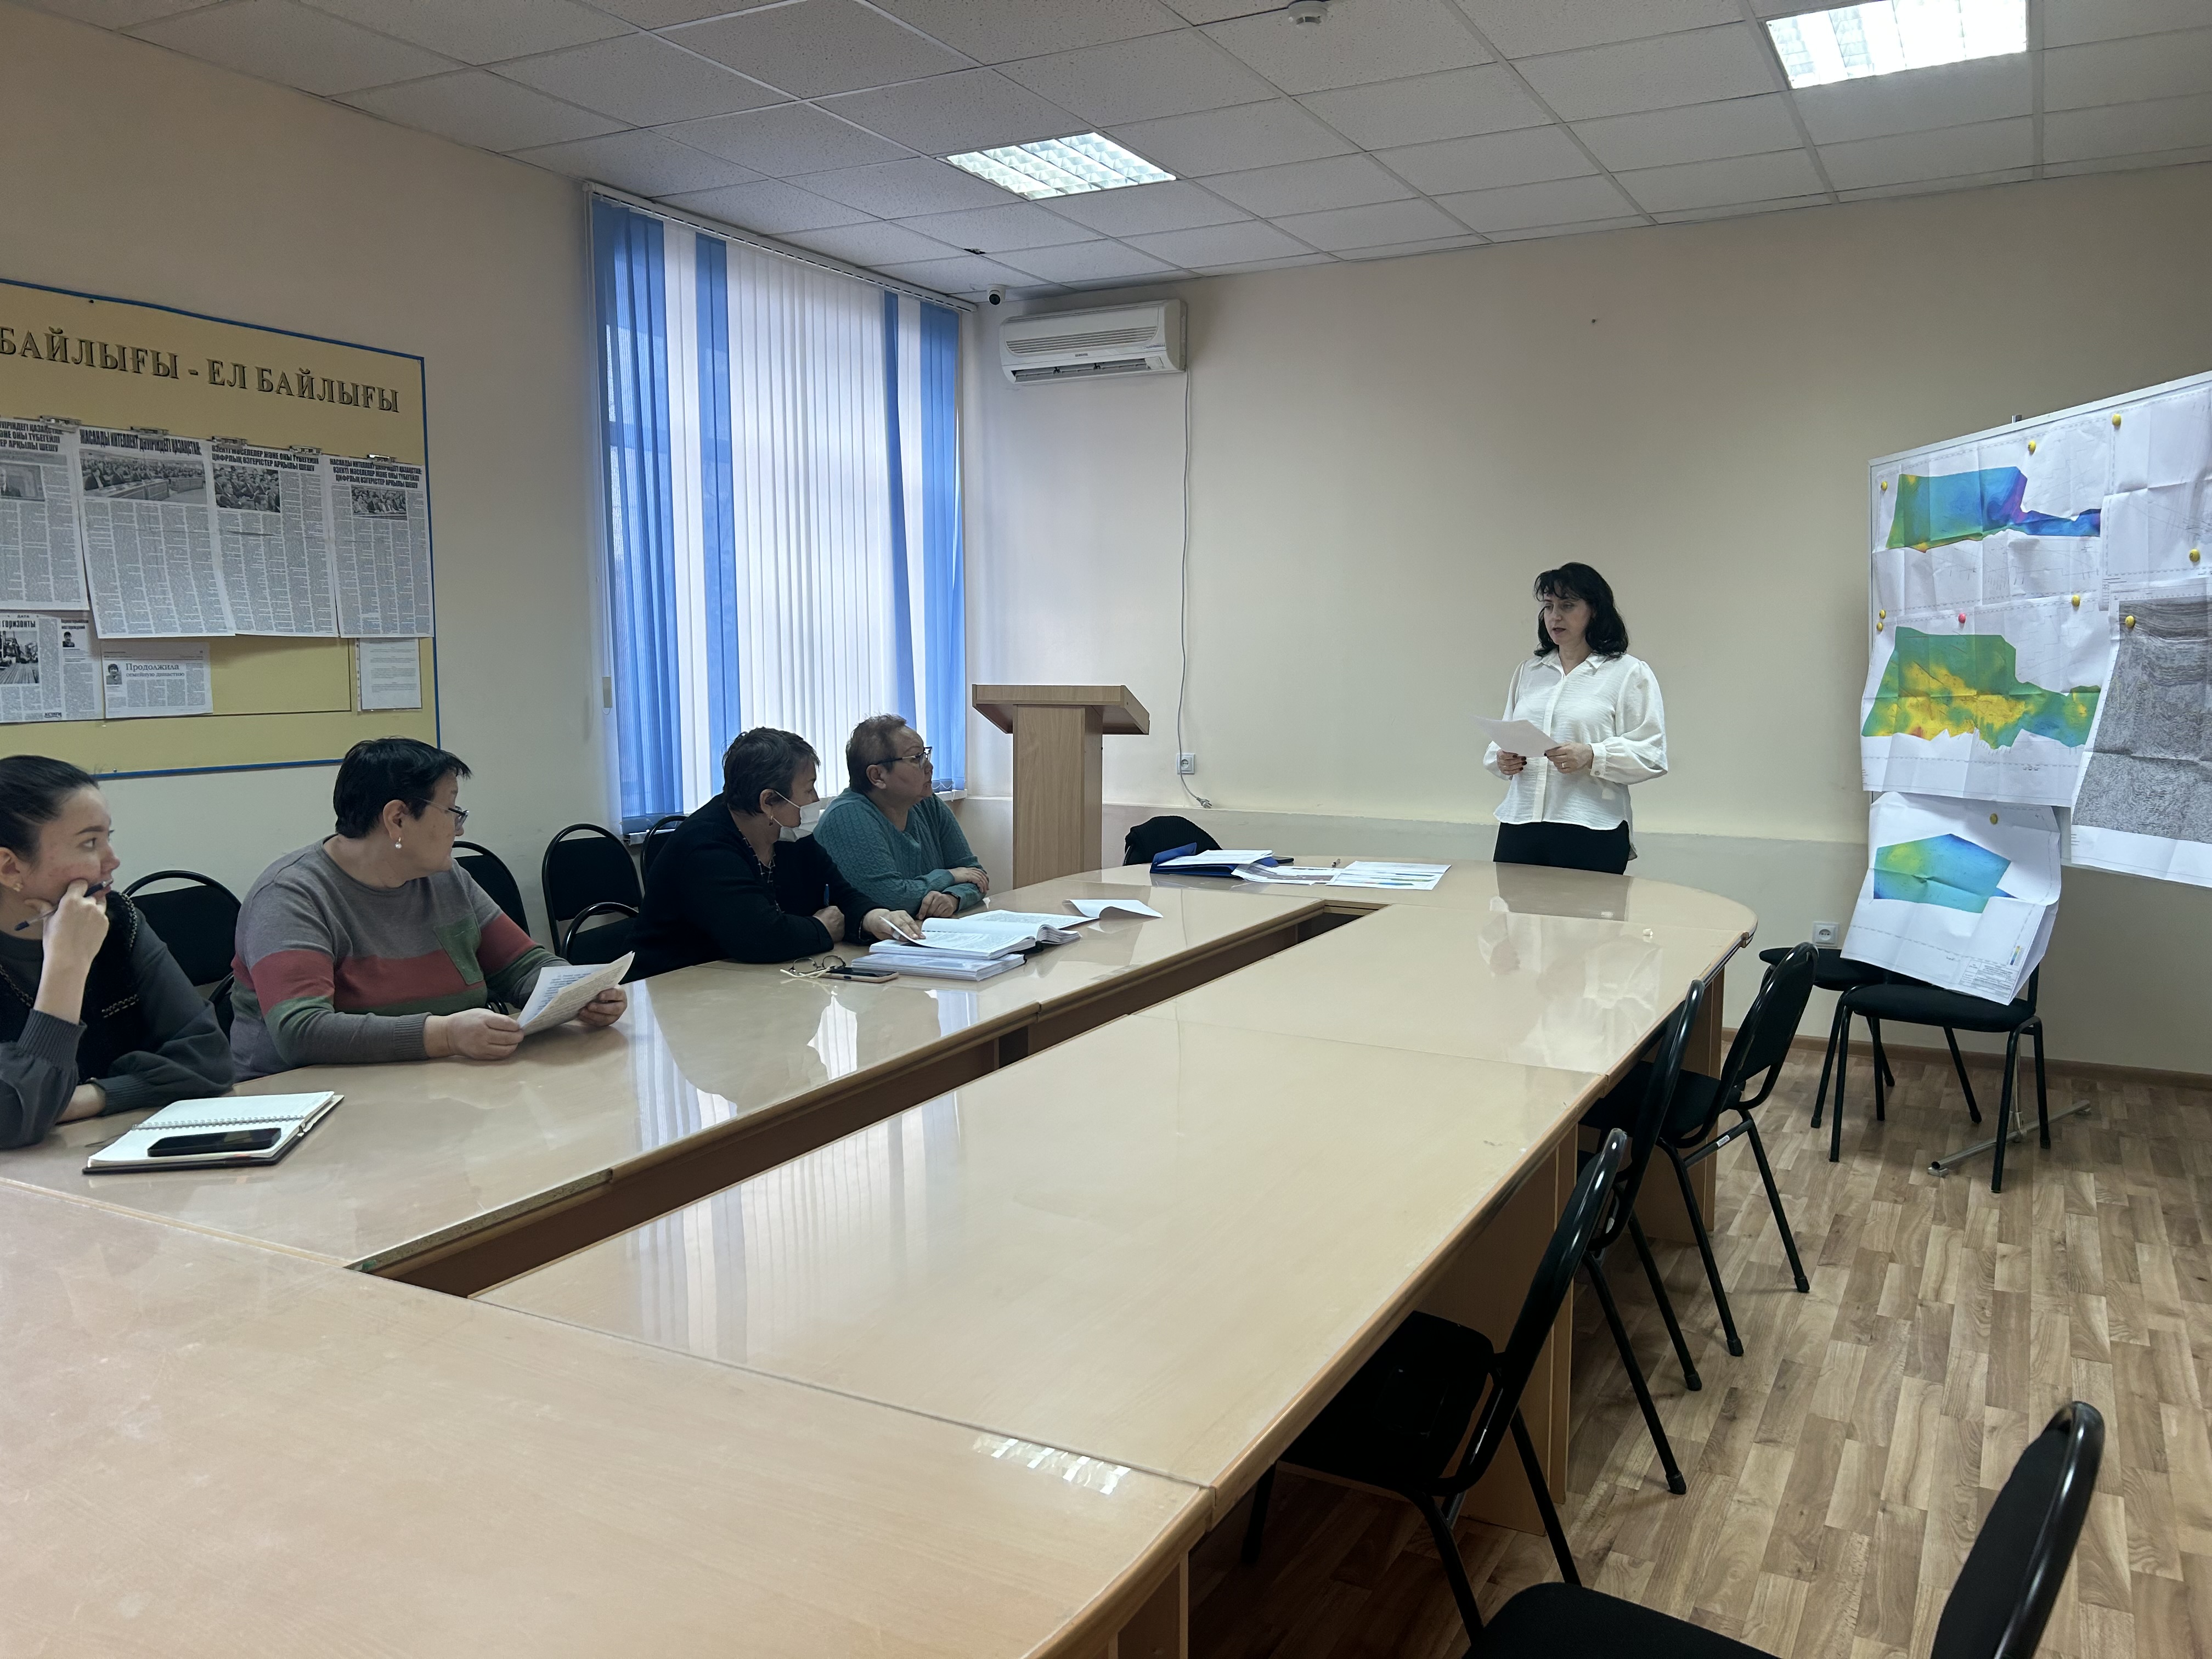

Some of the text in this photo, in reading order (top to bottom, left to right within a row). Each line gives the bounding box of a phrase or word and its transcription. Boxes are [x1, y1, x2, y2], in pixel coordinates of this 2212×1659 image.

[0, 326, 179, 380] БАЙЛЫҒЫ
[206, 358, 248, 390] ЕЛ
[255, 366, 399, 413] БАЙЛЫҒЫ
[126, 663, 179, 672] Продолжила
